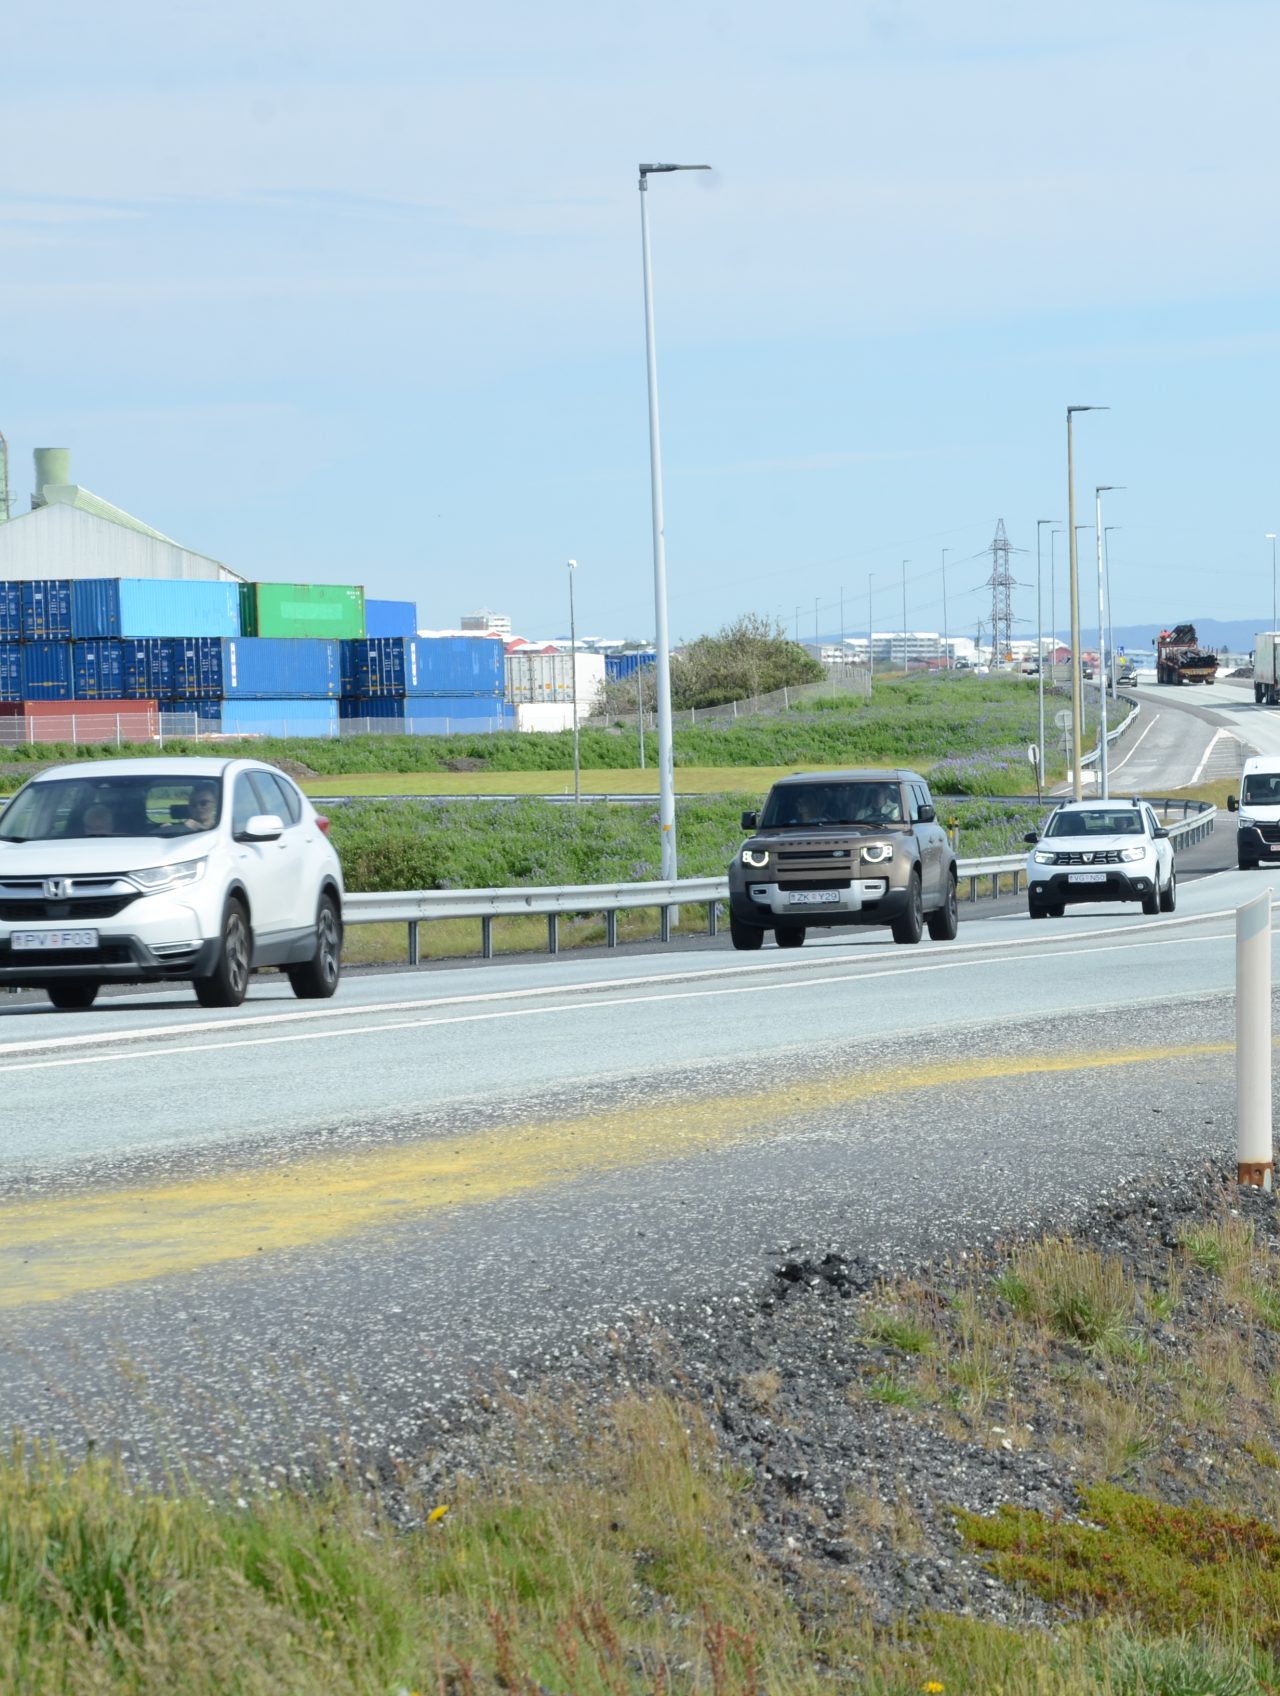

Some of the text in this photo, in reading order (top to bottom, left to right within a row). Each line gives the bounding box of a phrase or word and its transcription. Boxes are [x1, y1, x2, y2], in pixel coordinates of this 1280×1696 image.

[797, 892, 837, 901] ZK Y29
[25, 934, 48, 946] PV
